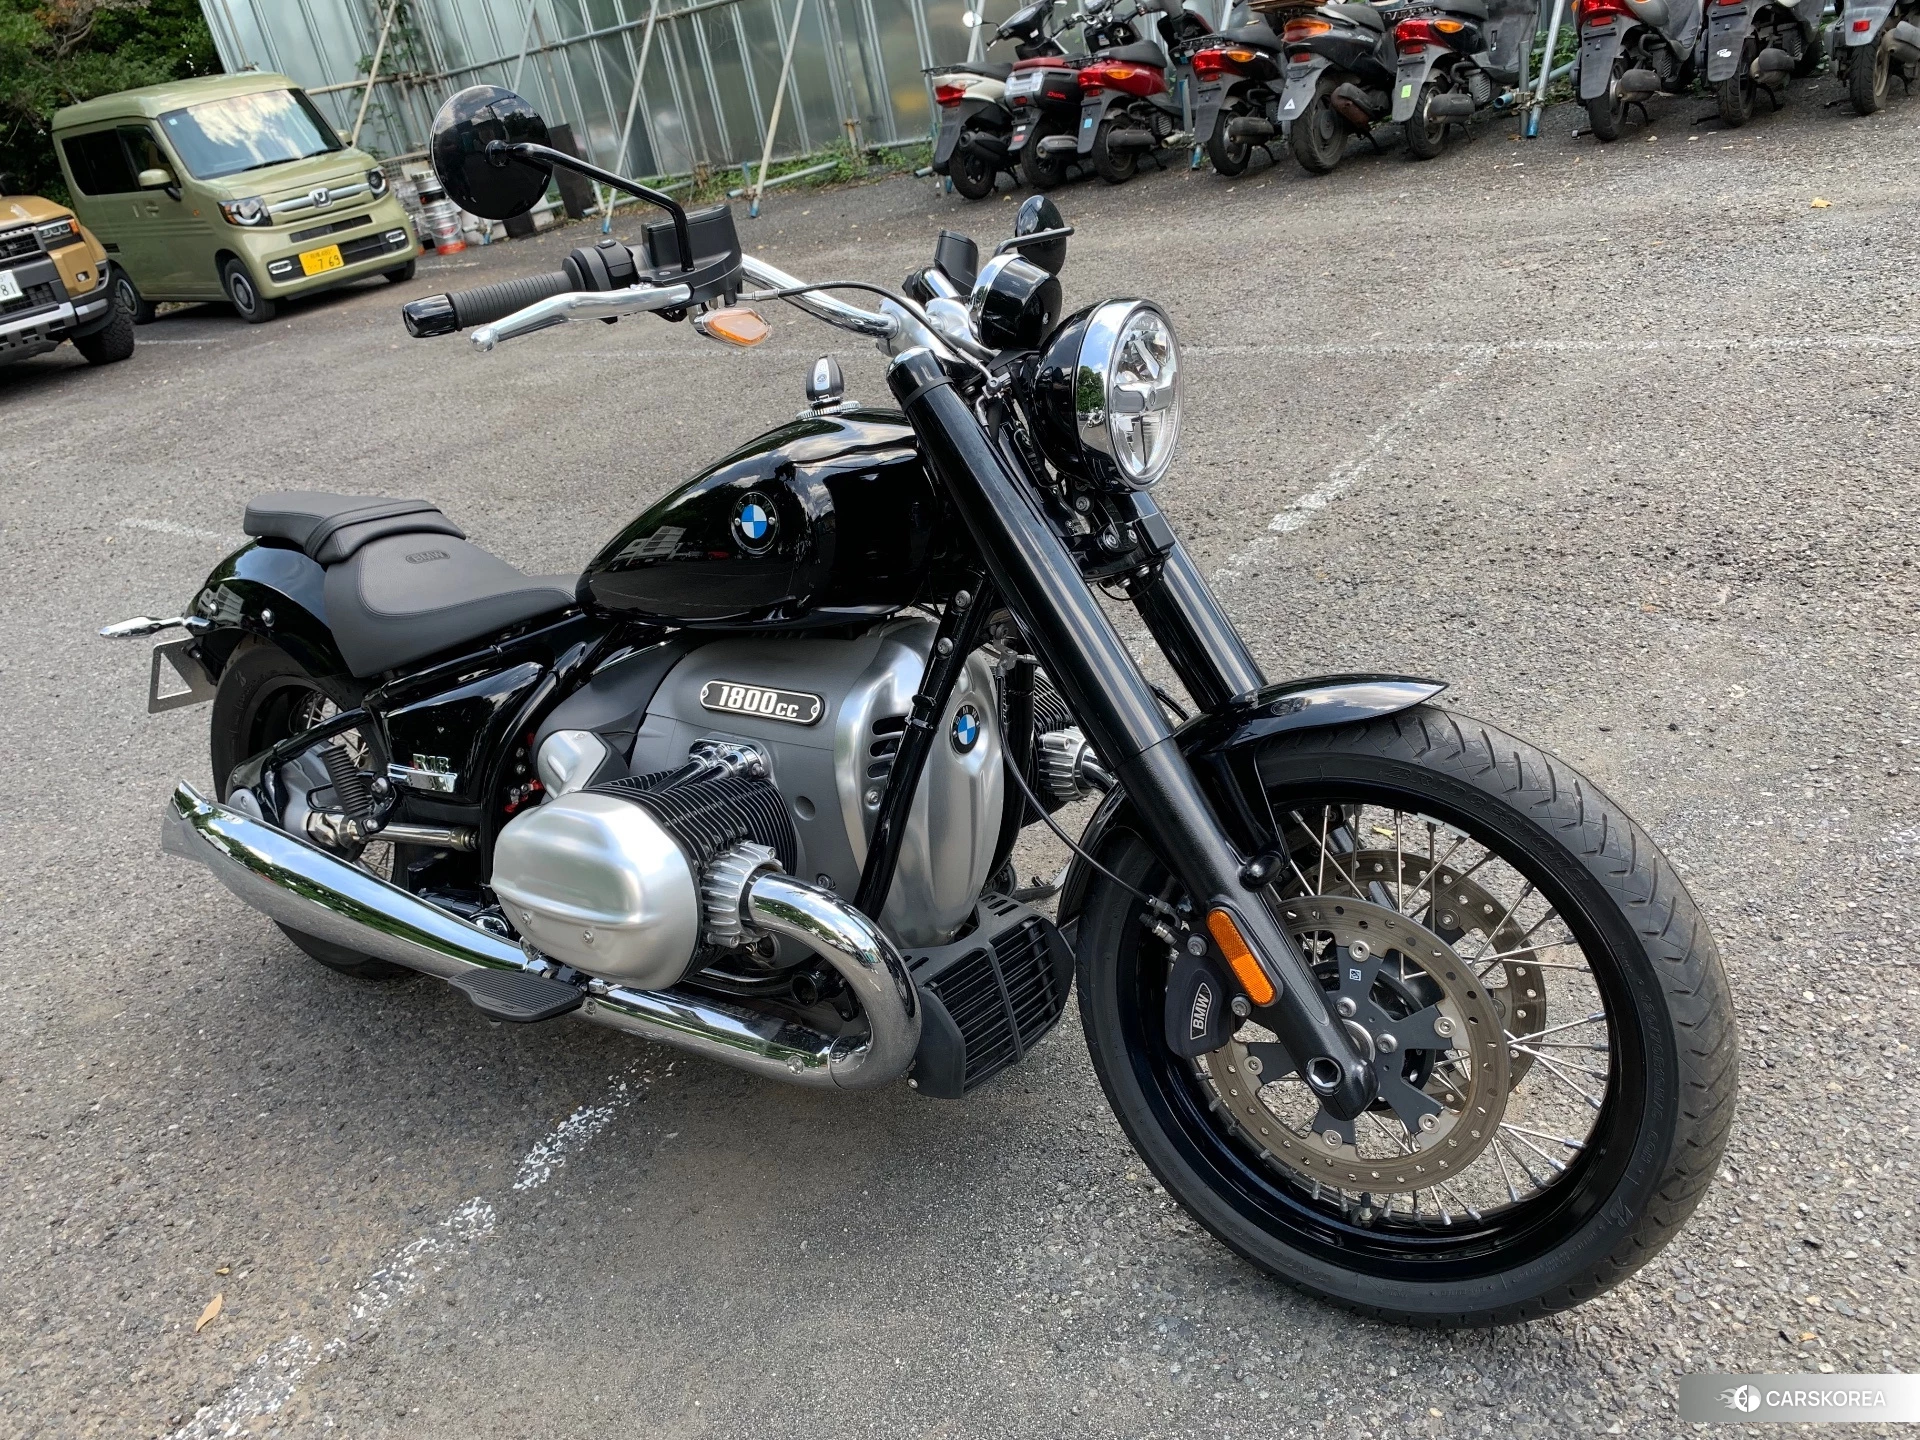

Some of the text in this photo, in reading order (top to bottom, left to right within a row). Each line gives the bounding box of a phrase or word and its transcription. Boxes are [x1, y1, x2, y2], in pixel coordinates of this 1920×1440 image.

[718, 685, 800, 719] 1800cc
[412, 753, 450, 774] R18
[1387, 765, 1589, 883] BRIDGESTONE
[1192, 993, 1210, 1030] BMW
